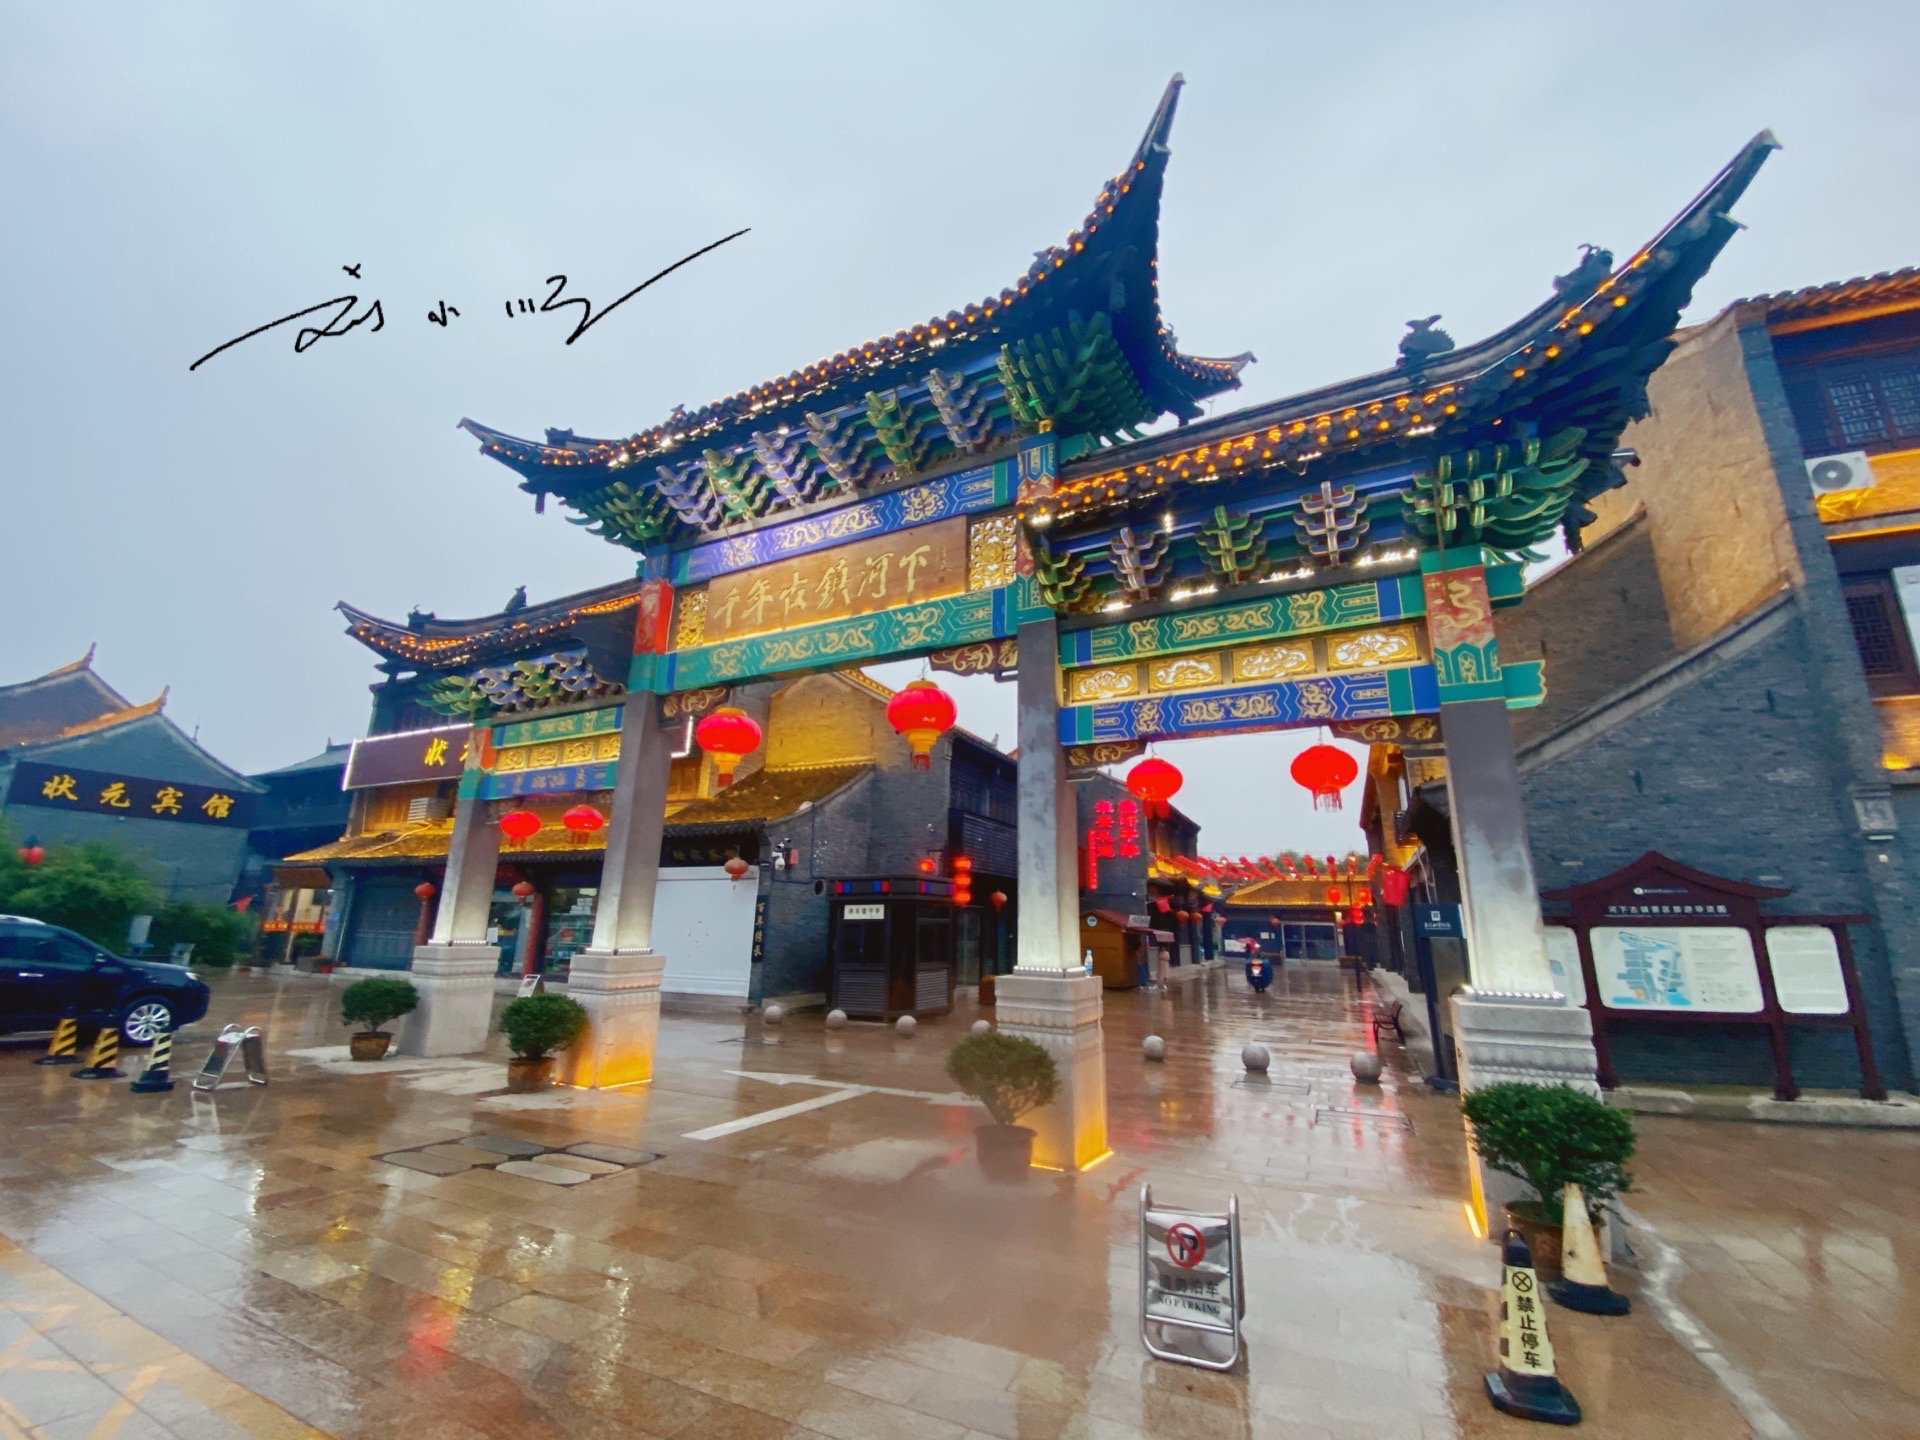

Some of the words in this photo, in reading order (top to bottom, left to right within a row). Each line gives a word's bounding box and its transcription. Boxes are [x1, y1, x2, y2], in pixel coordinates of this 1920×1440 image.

[42, 774, 235, 818] 状元宾馆
[1174, 1298, 1220, 1314] PARKING
[1516, 1295, 1541, 1368] 禁止停车
